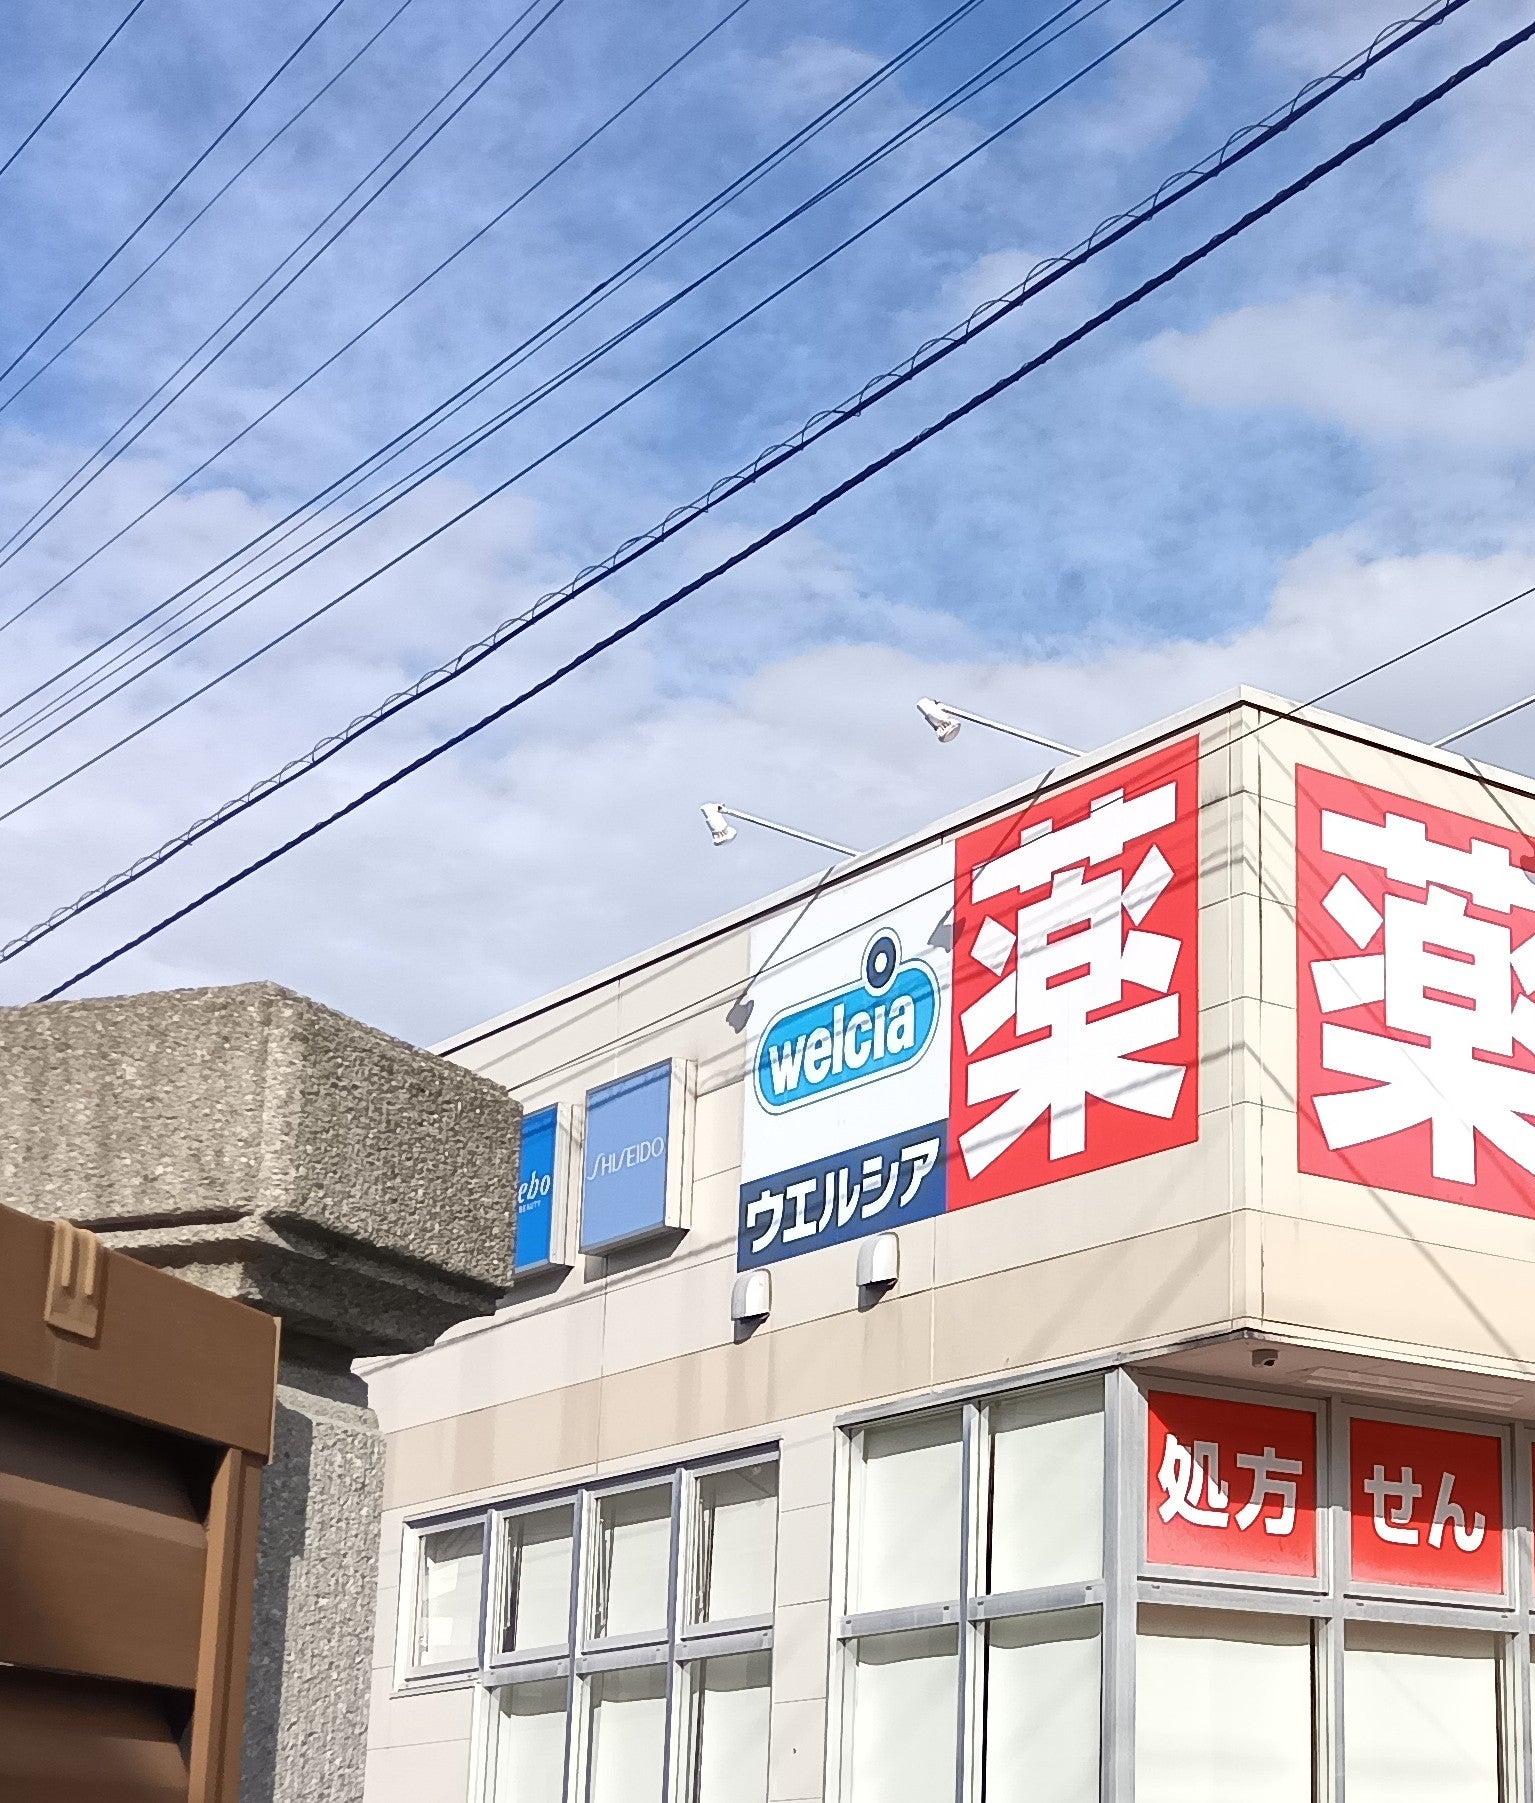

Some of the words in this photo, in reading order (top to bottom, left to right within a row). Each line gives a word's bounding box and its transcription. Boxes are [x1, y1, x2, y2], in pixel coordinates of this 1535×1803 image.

[768, 937, 916, 1096] welcia
[958, 781, 1187, 1179] 薬
[518, 1170, 551, 1203] ebo
[586, 1136, 665, 1181] SHISEIDO
[746, 1137, 940, 1254] ウエルシア
[1157, 1432, 1303, 1536] 処方
[1363, 1464, 1486, 1552] せん
